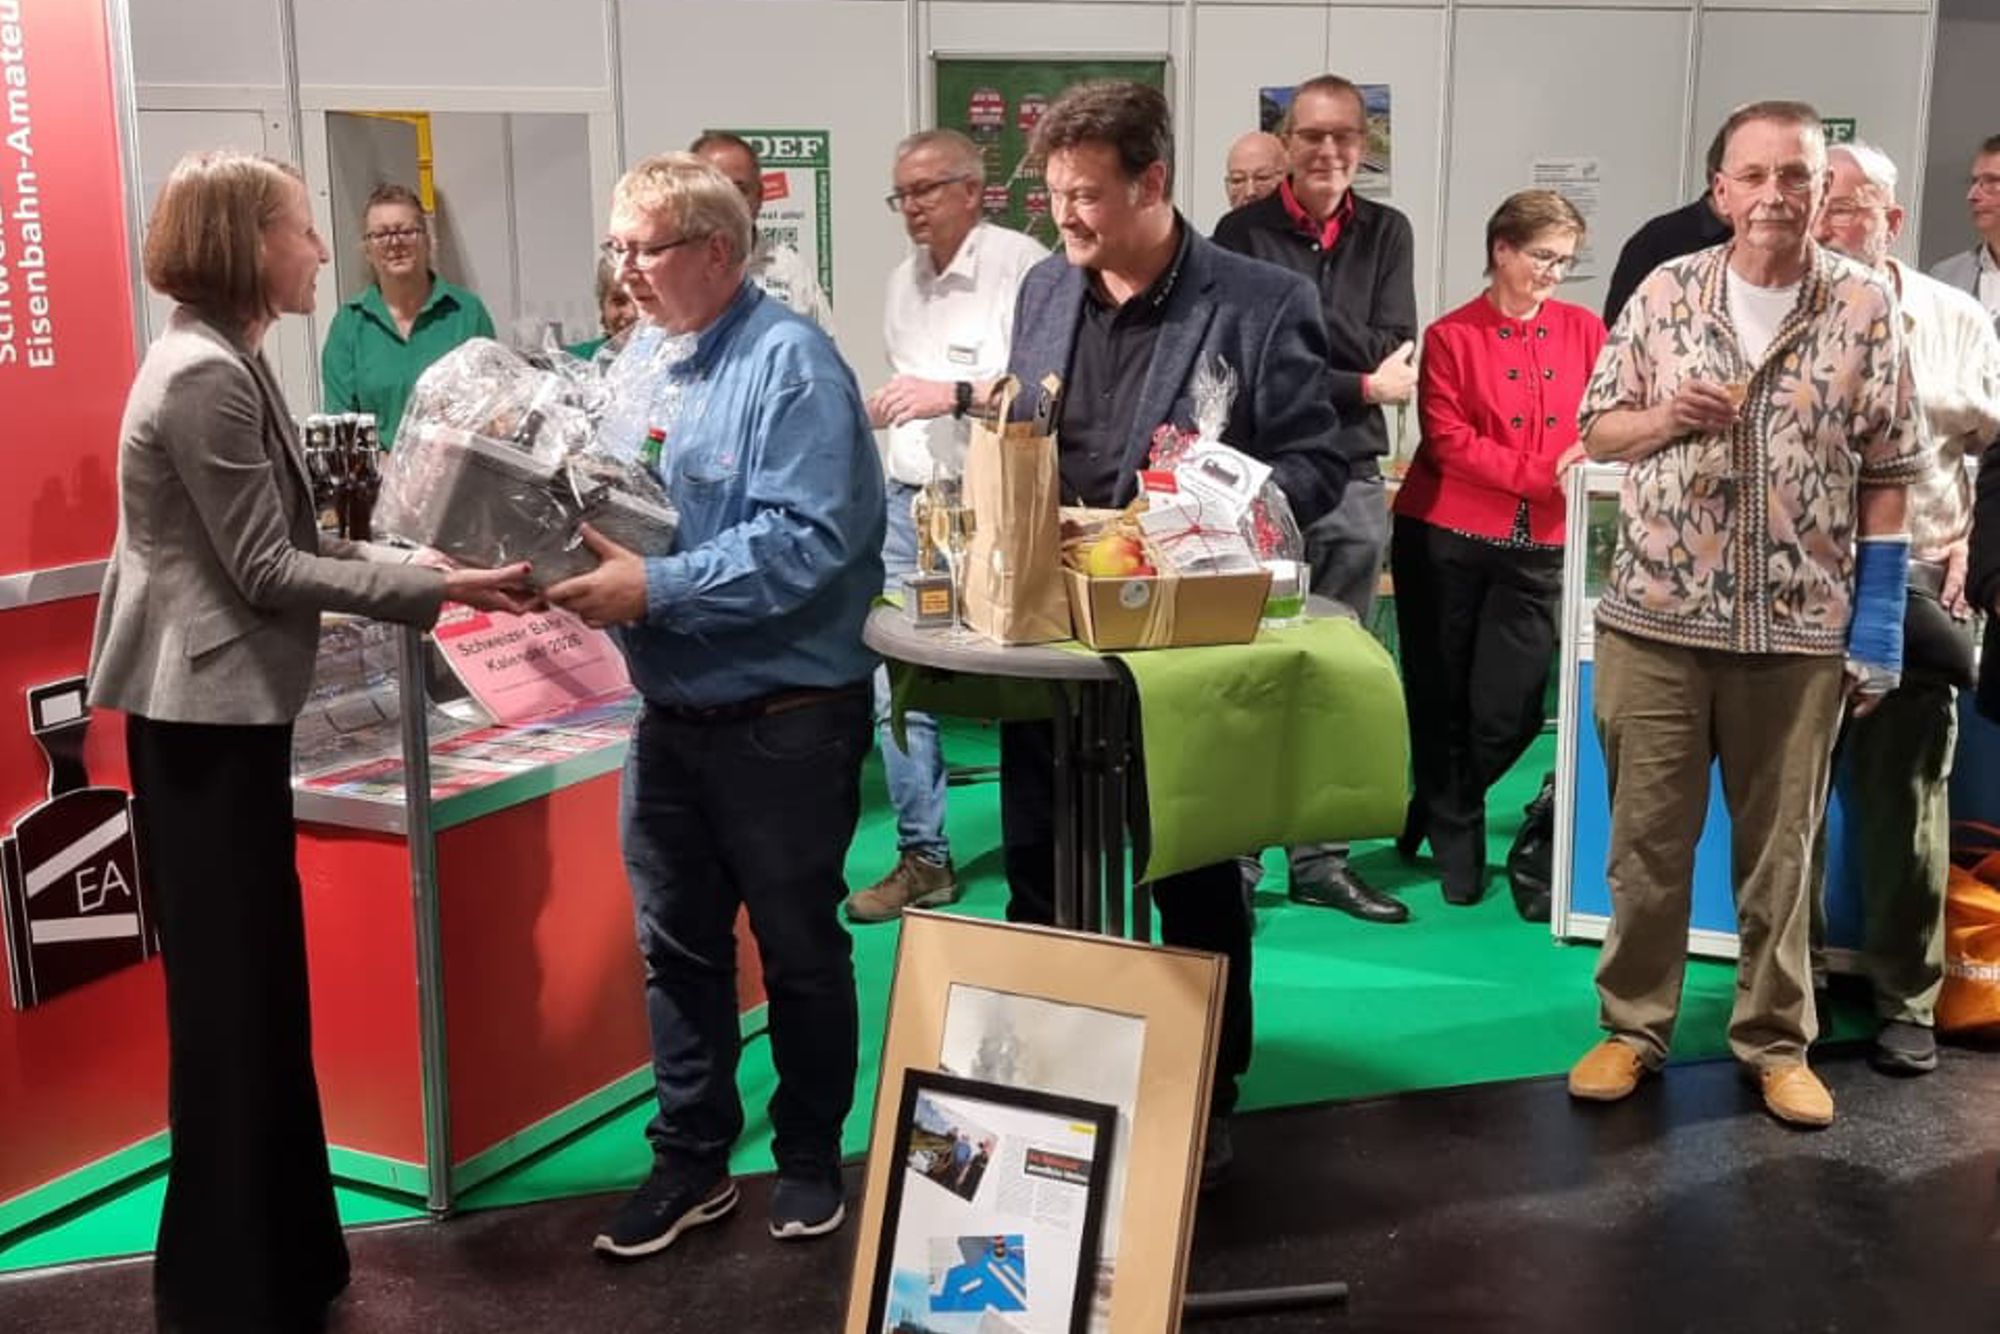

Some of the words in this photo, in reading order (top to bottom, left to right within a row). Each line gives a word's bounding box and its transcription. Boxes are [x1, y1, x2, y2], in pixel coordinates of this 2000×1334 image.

[741, 136, 824, 158] DEF
[0, 0, 55, 368] Eisenbahn-Amateu
[76, 860, 131, 913] EA
